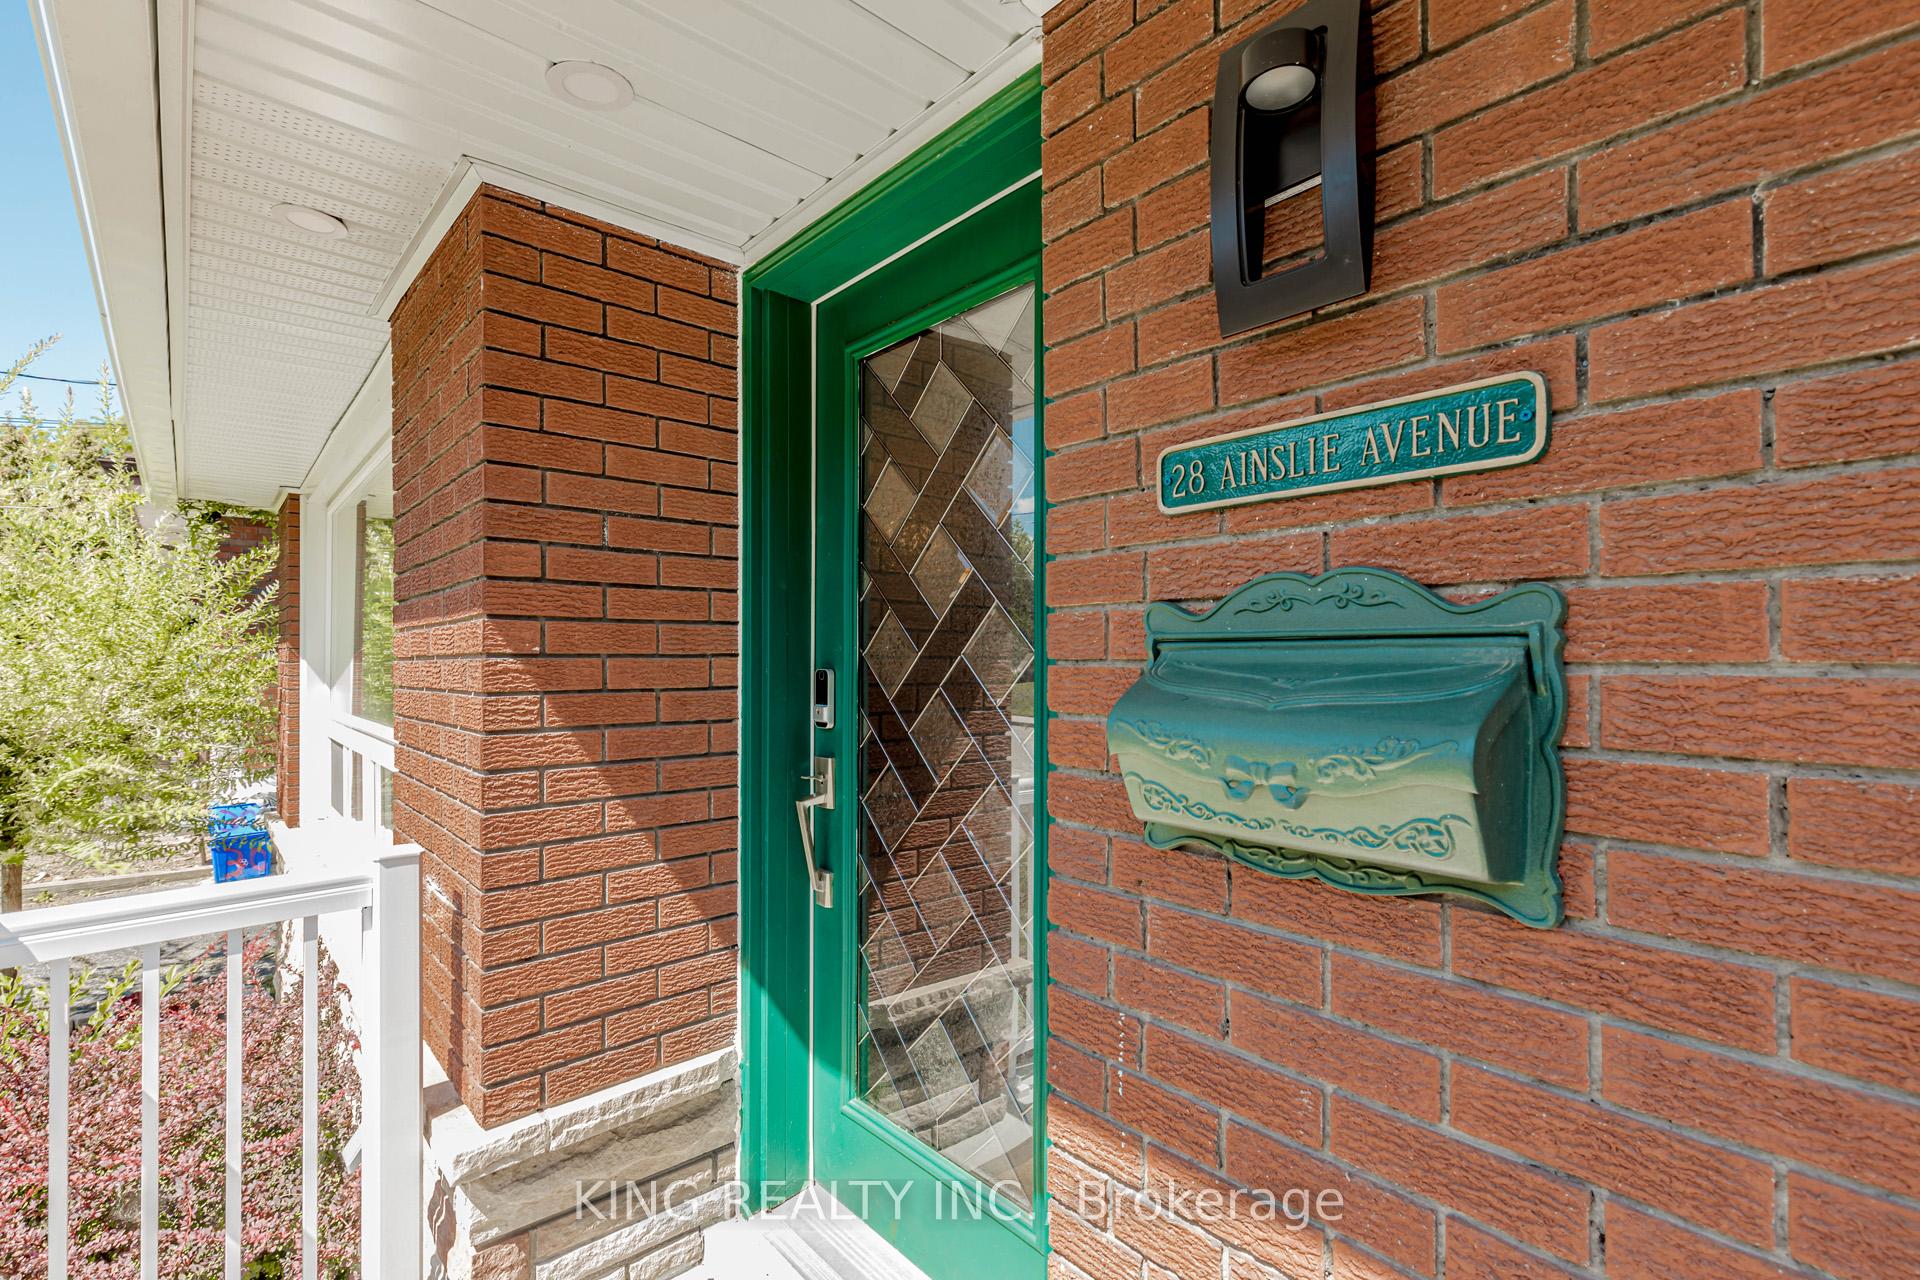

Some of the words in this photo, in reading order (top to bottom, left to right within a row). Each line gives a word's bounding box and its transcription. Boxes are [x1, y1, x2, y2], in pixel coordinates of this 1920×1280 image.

[1171, 460, 1205, 498] 28
[1220, 432, 1341, 490] AINSLIE
[1360, 398, 1521, 467] AVENUE
